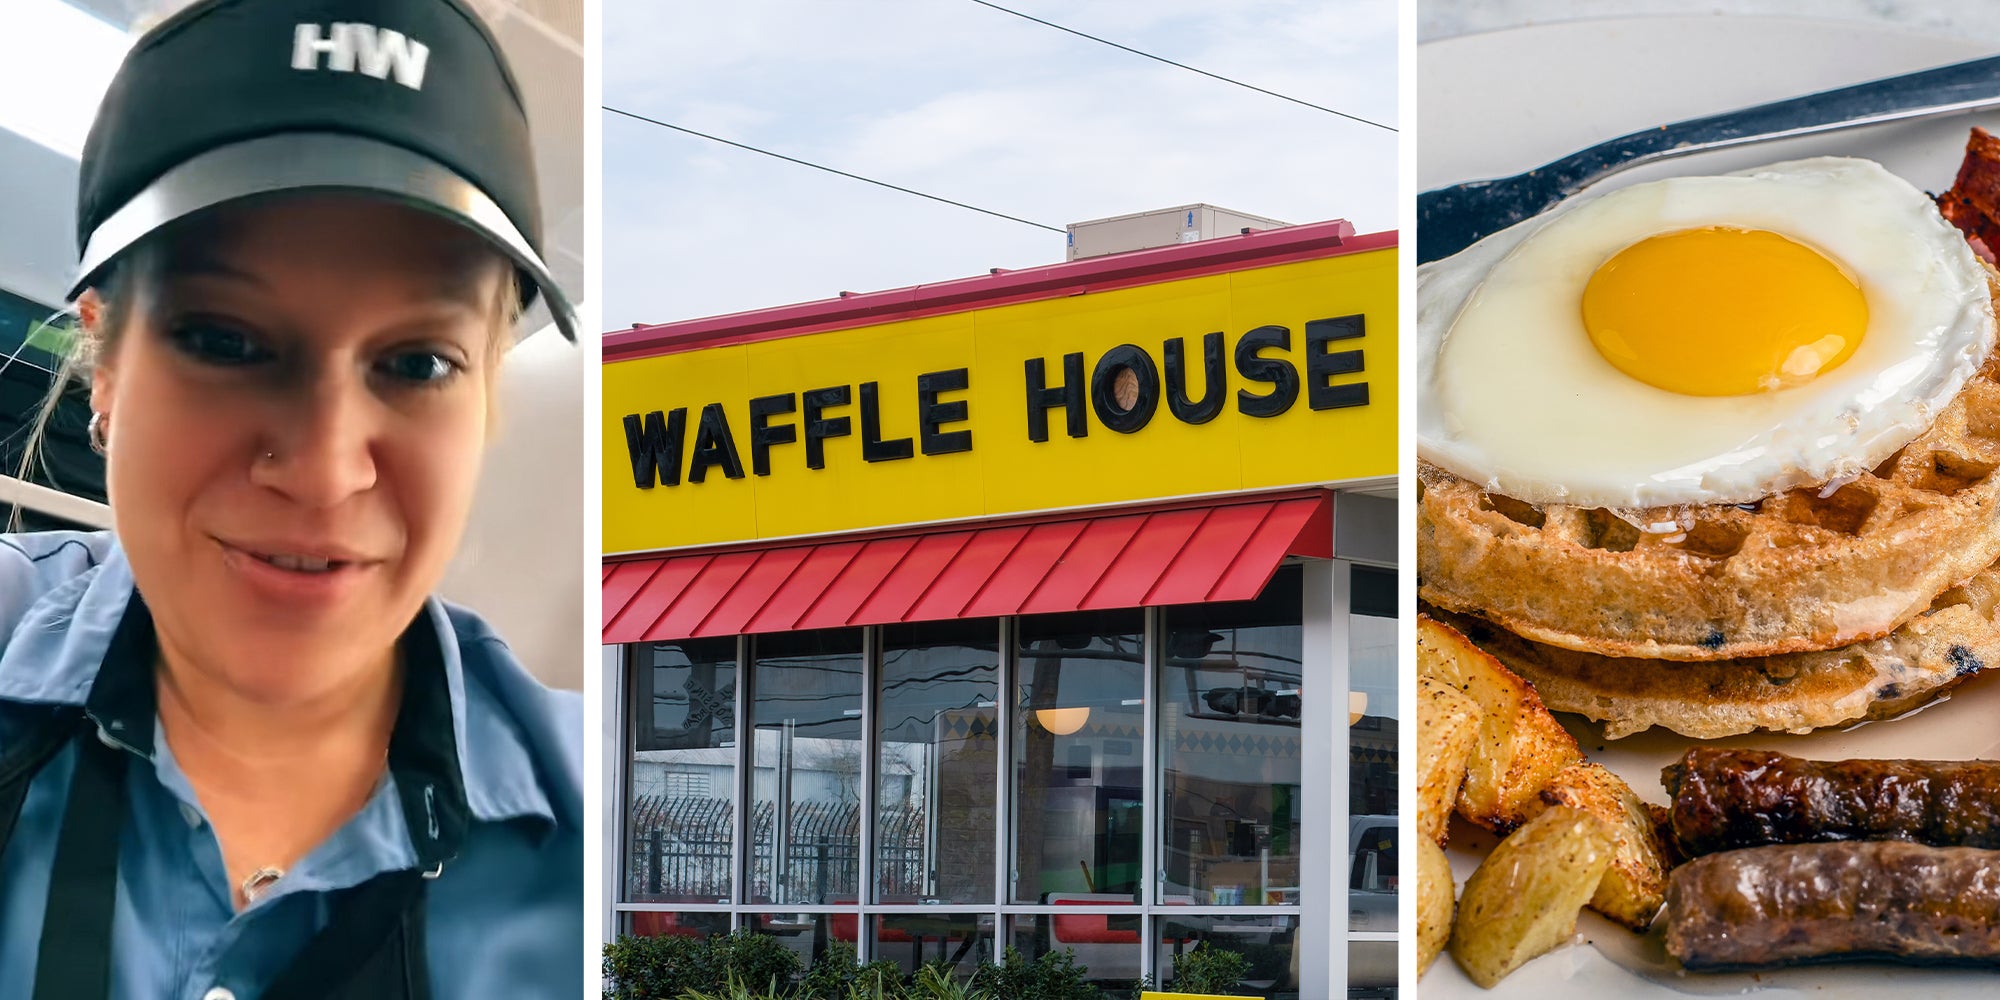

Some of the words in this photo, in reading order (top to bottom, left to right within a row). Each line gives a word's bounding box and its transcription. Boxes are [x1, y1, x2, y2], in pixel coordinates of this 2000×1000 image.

[291, 22, 430, 91] HW
[623, 367, 973, 490] WAFFLE
[1024, 313, 1370, 443] HOUSE
